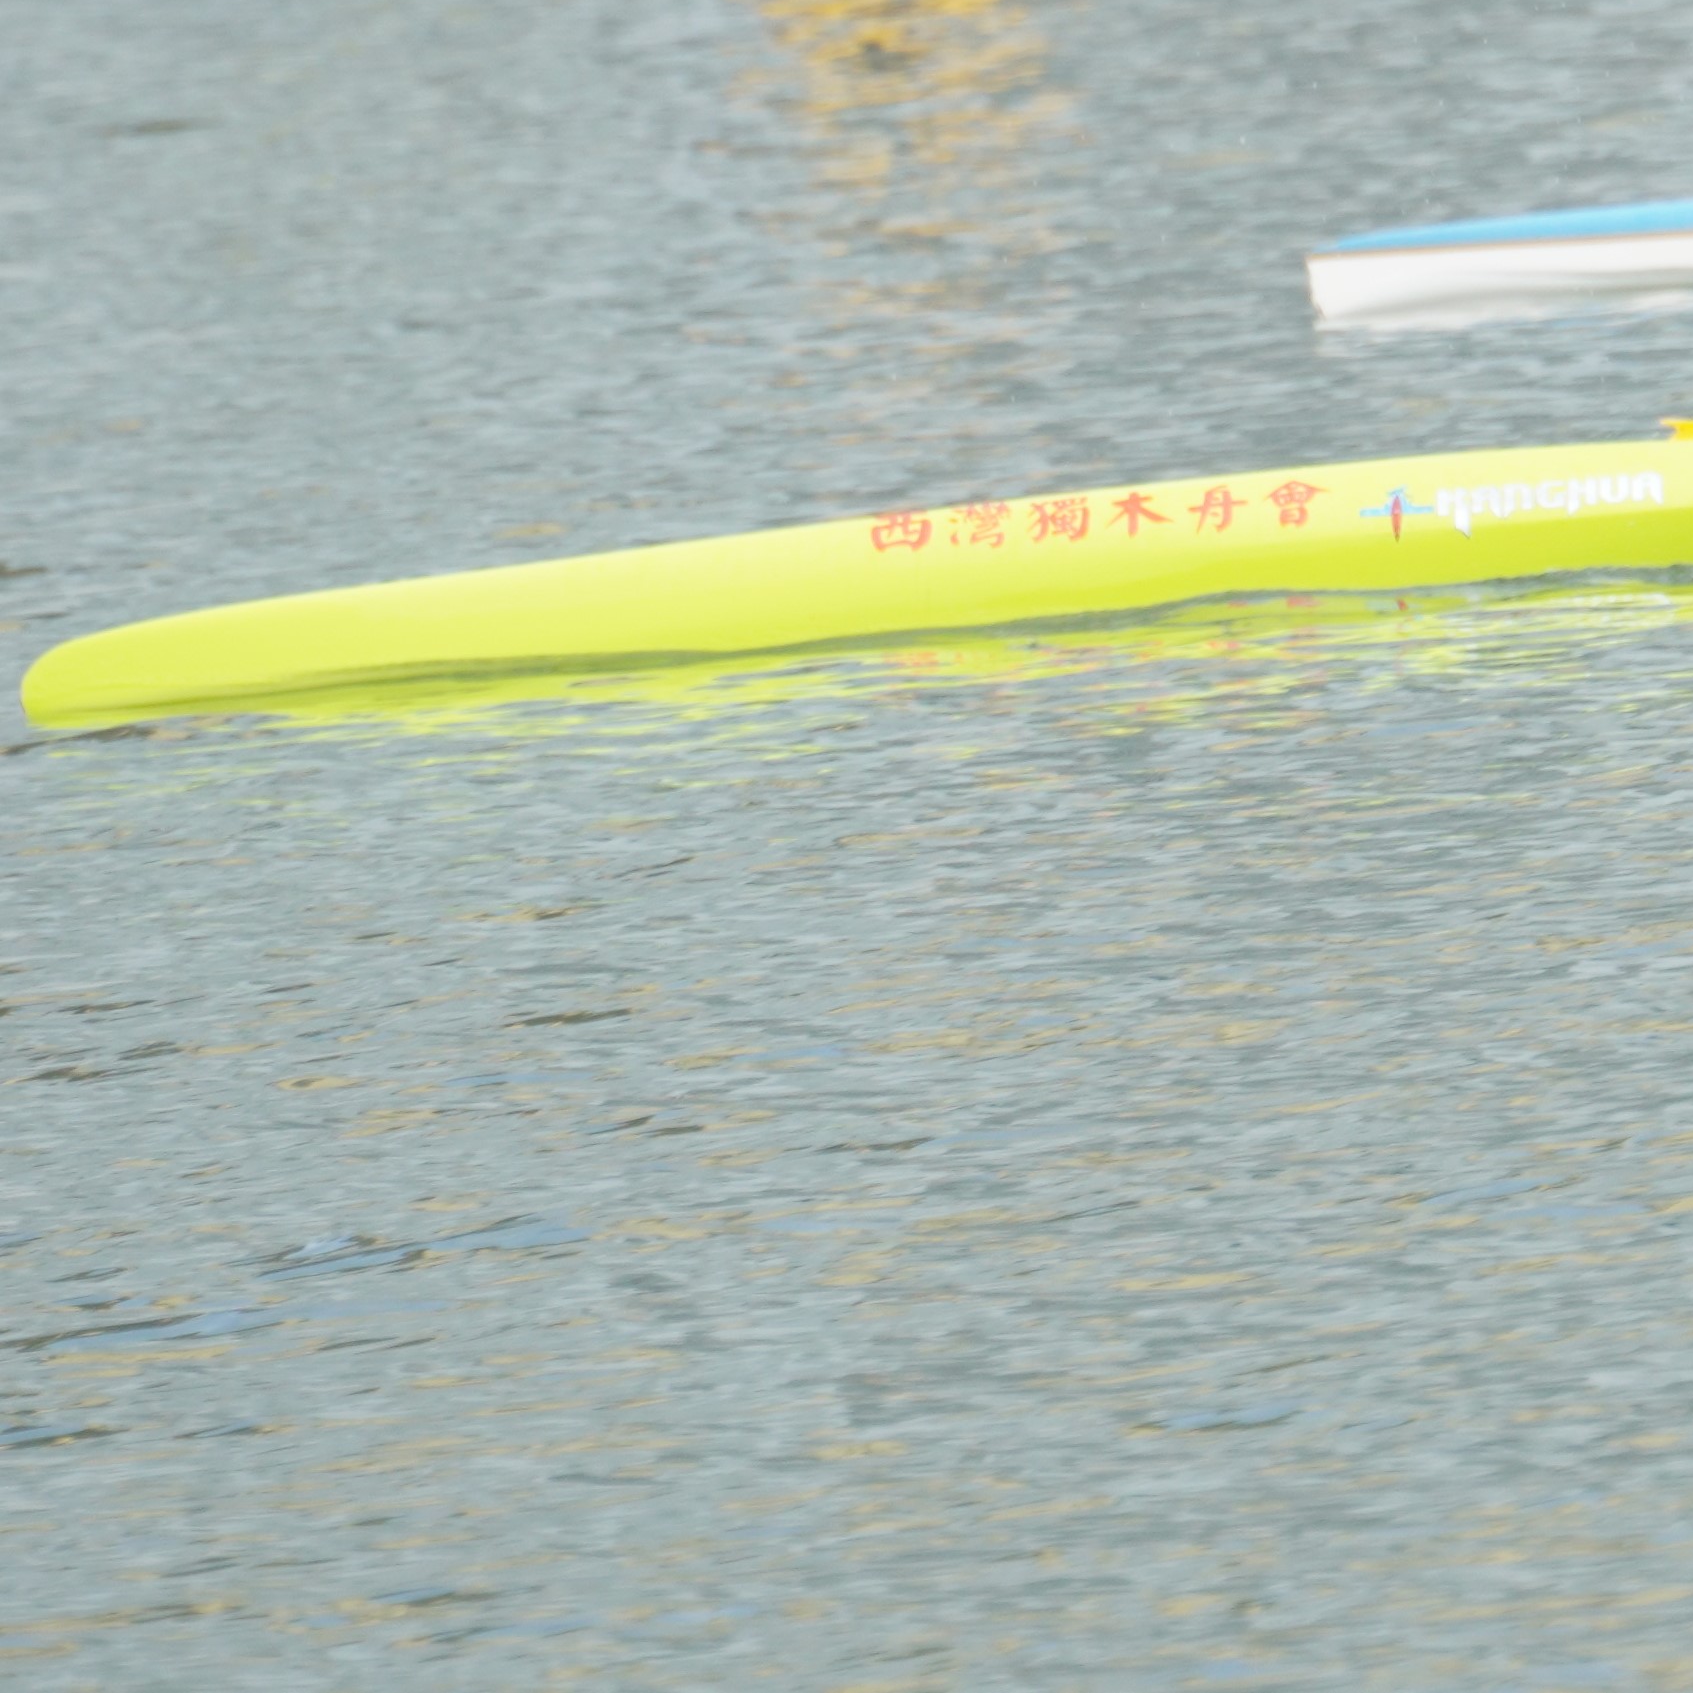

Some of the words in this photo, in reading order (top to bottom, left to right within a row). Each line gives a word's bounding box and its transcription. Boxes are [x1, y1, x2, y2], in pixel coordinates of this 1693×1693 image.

[869, 478, 1332, 553] 西灣獨木舟會
